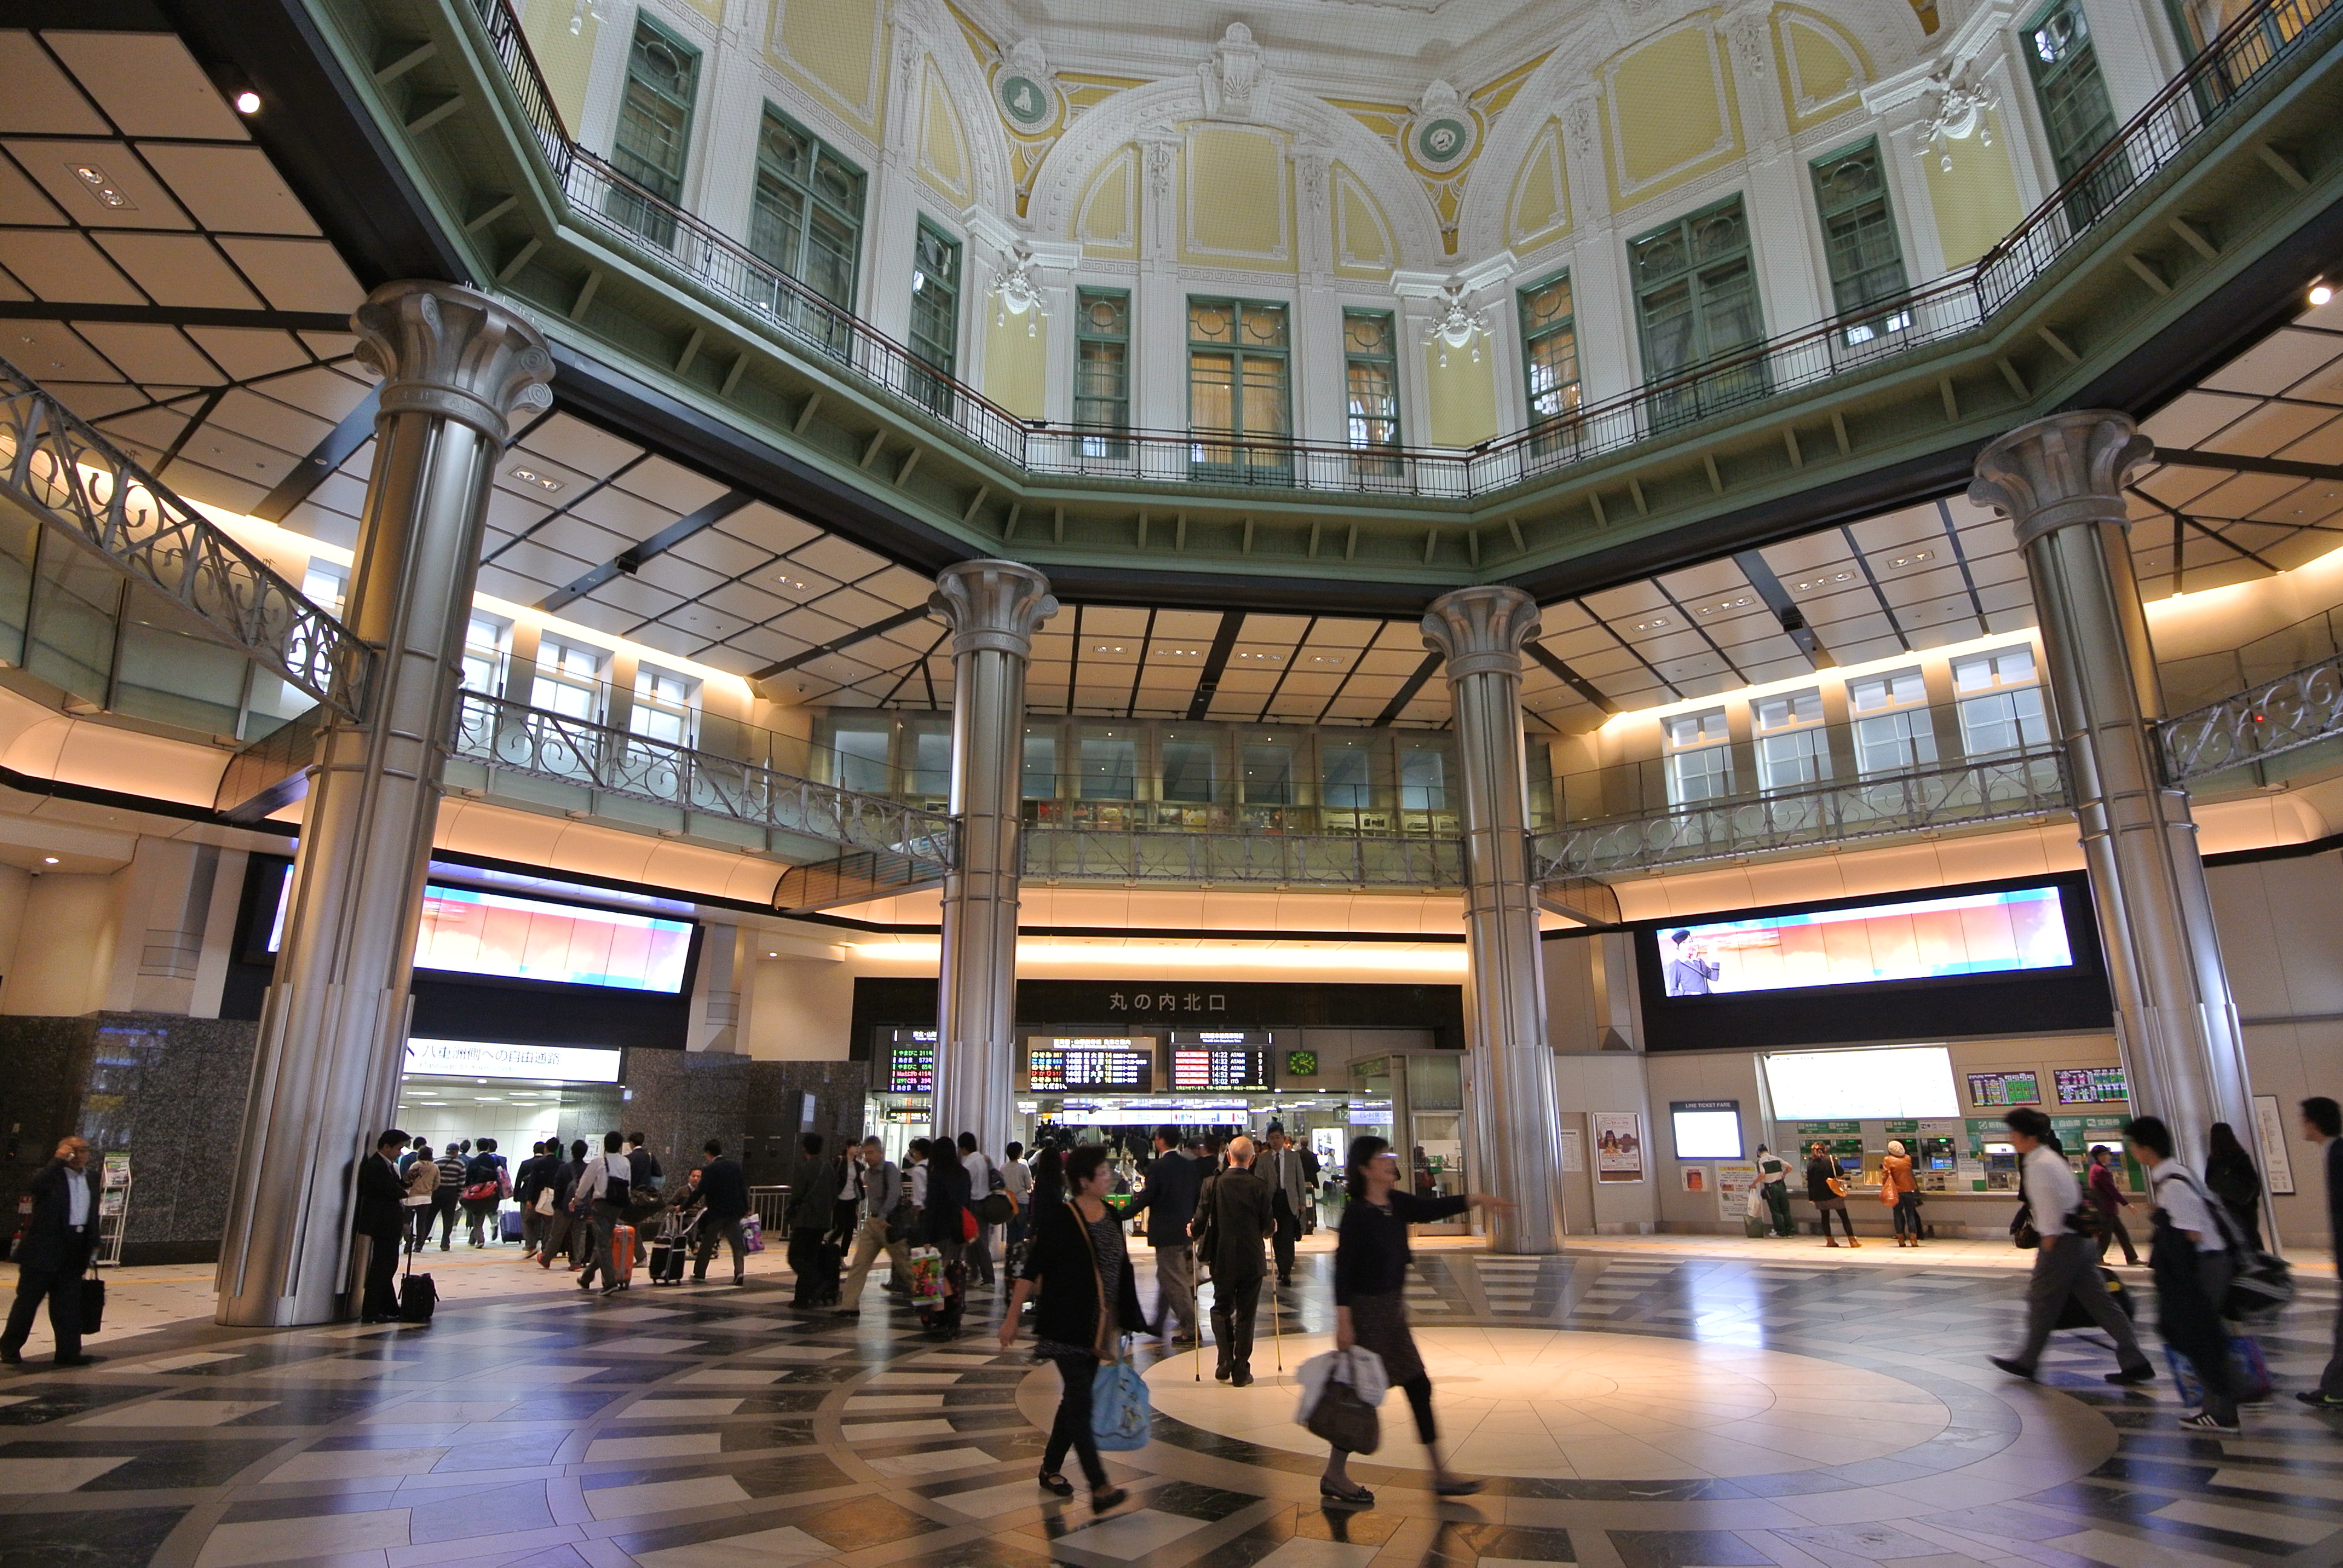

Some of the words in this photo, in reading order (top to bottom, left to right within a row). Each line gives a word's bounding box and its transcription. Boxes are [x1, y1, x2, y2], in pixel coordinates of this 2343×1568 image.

[1110, 992, 1225, 1011] 丸の内北口
[422, 1045, 560, 1065] 八重洲側への自由通路
